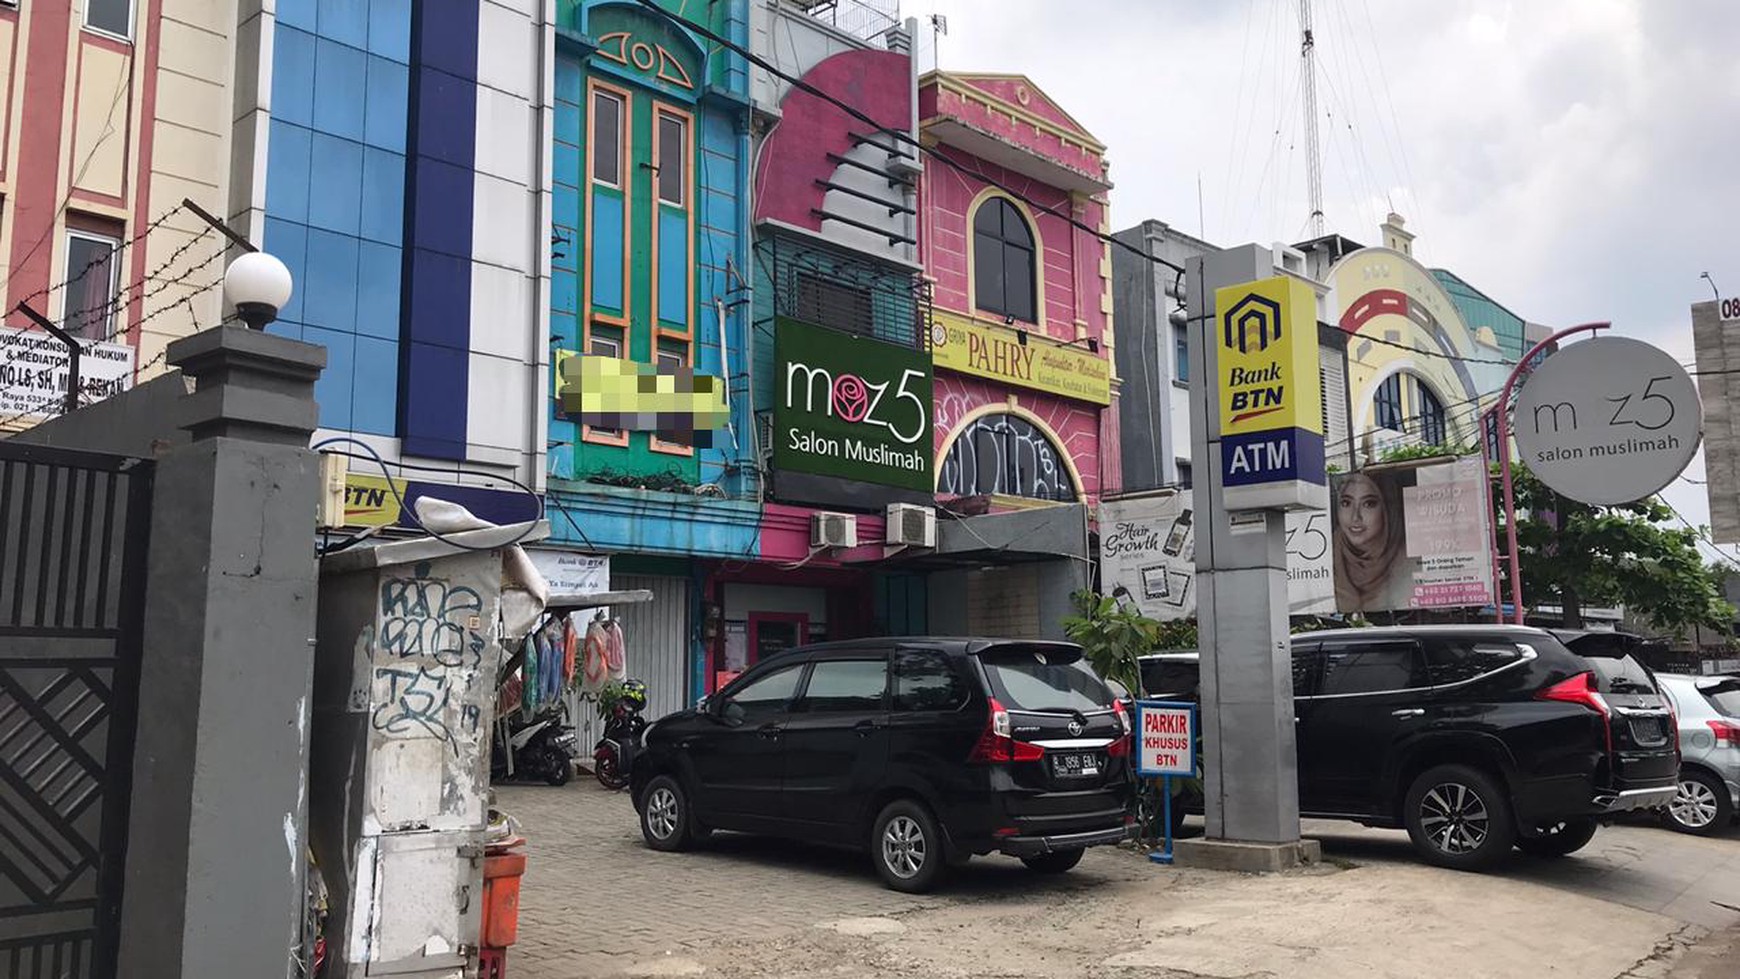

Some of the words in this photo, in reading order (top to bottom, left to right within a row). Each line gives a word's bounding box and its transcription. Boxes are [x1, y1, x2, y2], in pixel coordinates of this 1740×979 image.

[94, 349, 128, 362] HUKUM
[968, 331, 1036, 381] PAHRY
[1229, 361, 1283, 387] Bank
[1230, 386, 1285, 412] BTN
[788, 427, 840, 457] Salon
[844, 439, 925, 473] Muslimah
[1229, 440, 1290, 475] ATM
[1537, 447, 1584, 463] salon
[1589, 435, 1681, 458] muslimah
[1115, 522, 1150, 541] Hair
[1102, 533, 1158, 559] Growth
[1145, 713, 1188, 735] PARKIR
[1145, 737, 1188, 750] KHUSUS
[1156, 754, 1178, 767] BTN
